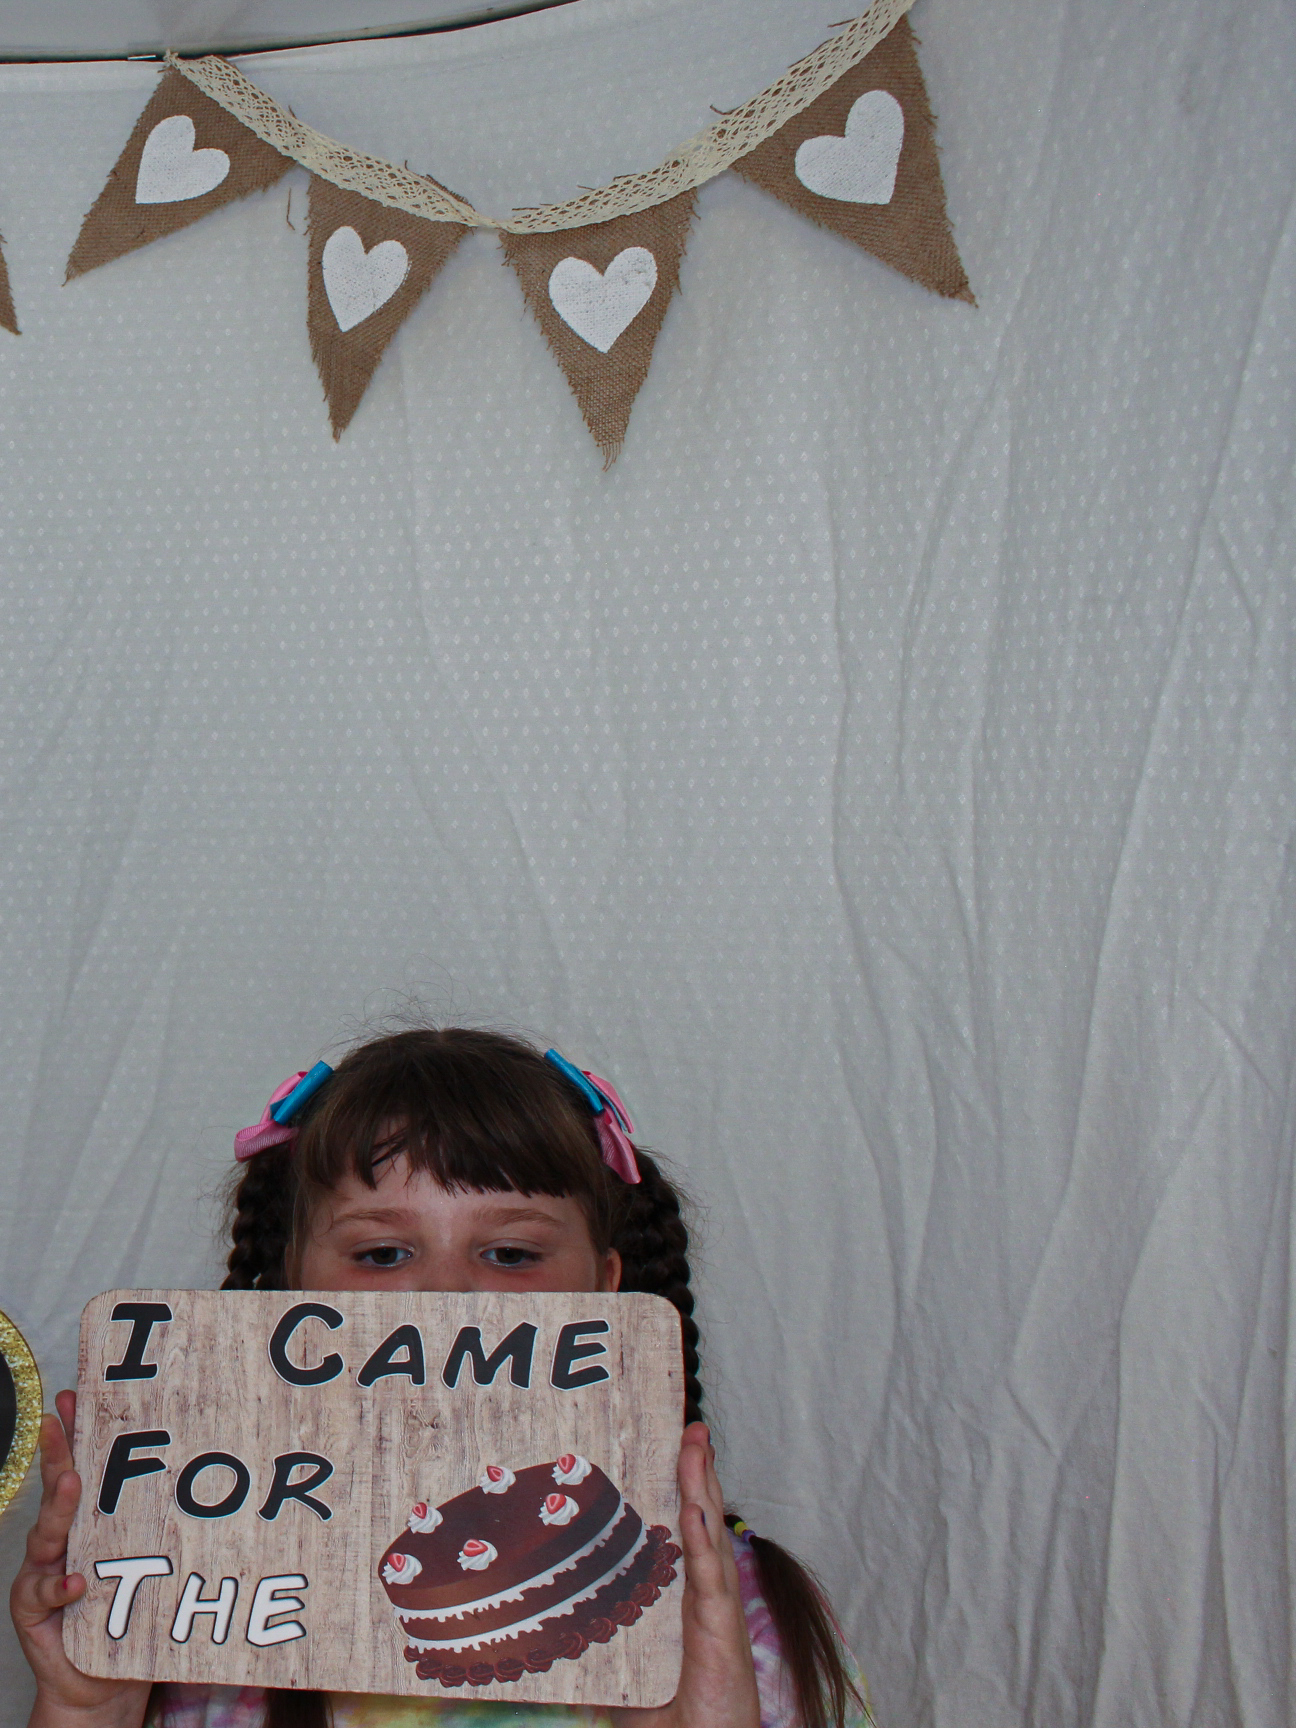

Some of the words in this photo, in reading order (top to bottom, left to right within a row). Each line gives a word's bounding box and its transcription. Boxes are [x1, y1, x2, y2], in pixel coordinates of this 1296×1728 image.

[105, 1302, 172, 1382] I
[268, 1302, 611, 1390] CAME
[97, 1430, 335, 1522] FOR
[94, 1555, 309, 1648] THE
